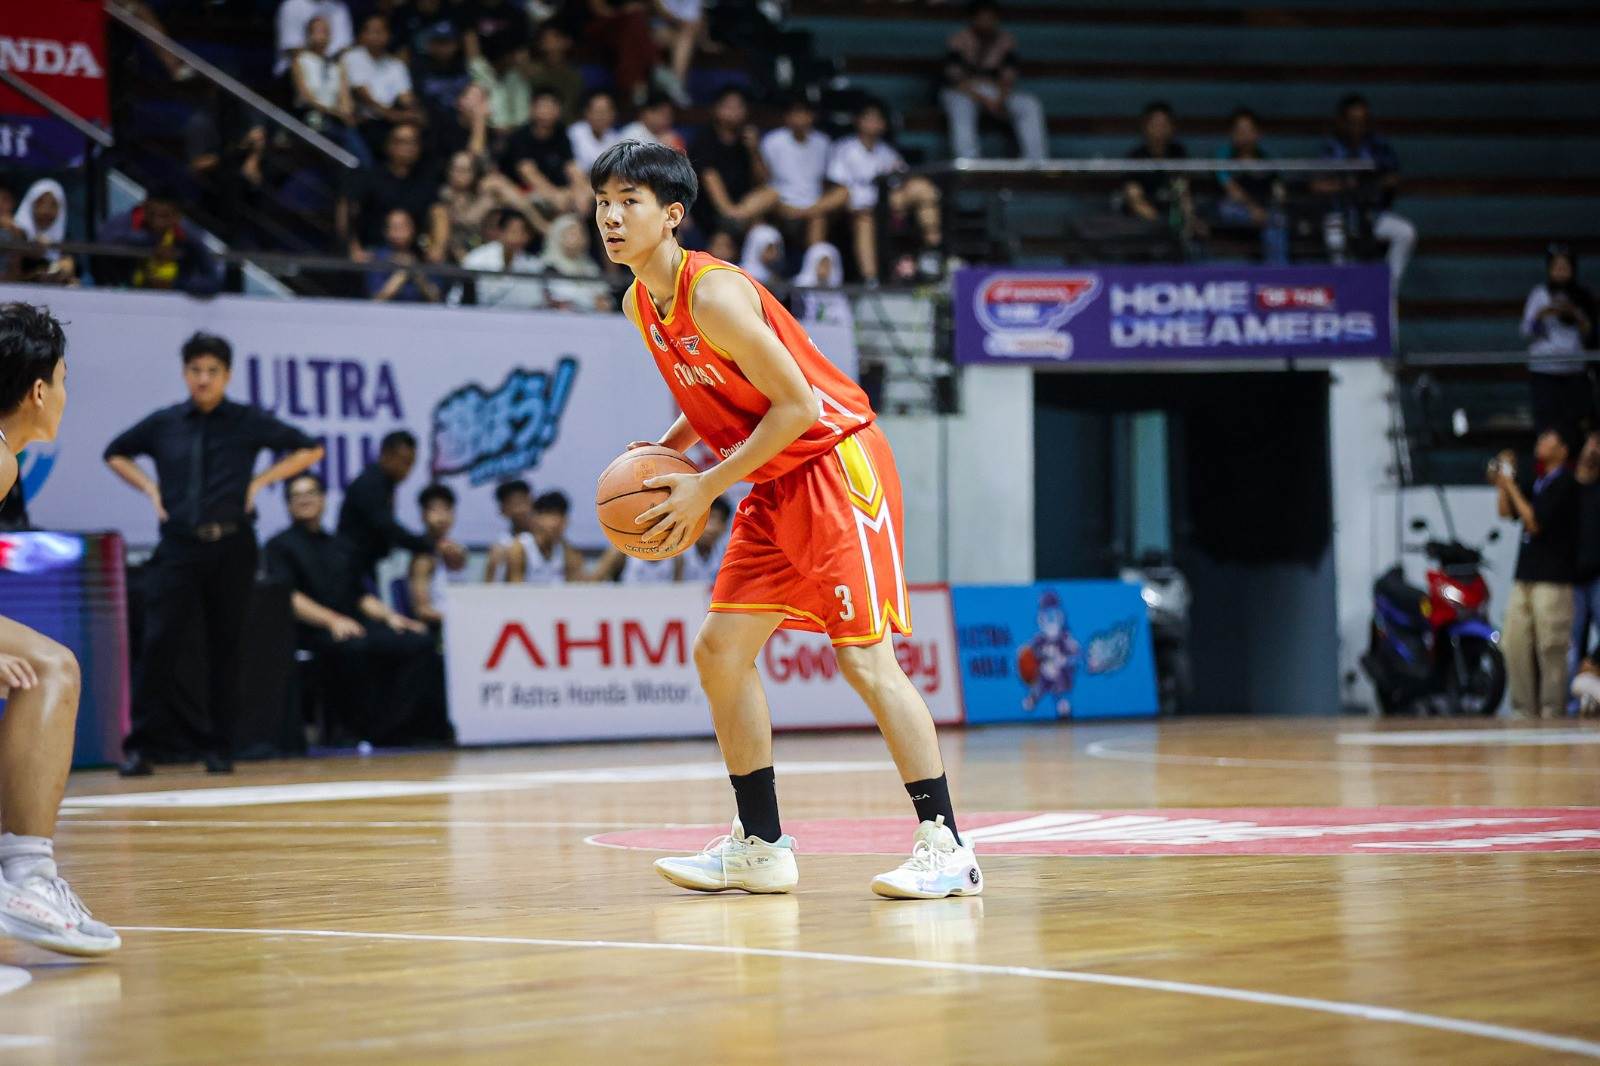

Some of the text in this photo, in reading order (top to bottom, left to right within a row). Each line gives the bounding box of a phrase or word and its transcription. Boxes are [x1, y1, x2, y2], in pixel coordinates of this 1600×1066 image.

[1109, 281, 1250, 313] HOME
[1109, 311, 1377, 347] DREAMERS
[246, 356, 403, 419] ULTRA
[834, 584, 855, 621] 3
[484, 620, 688, 671] AHM
